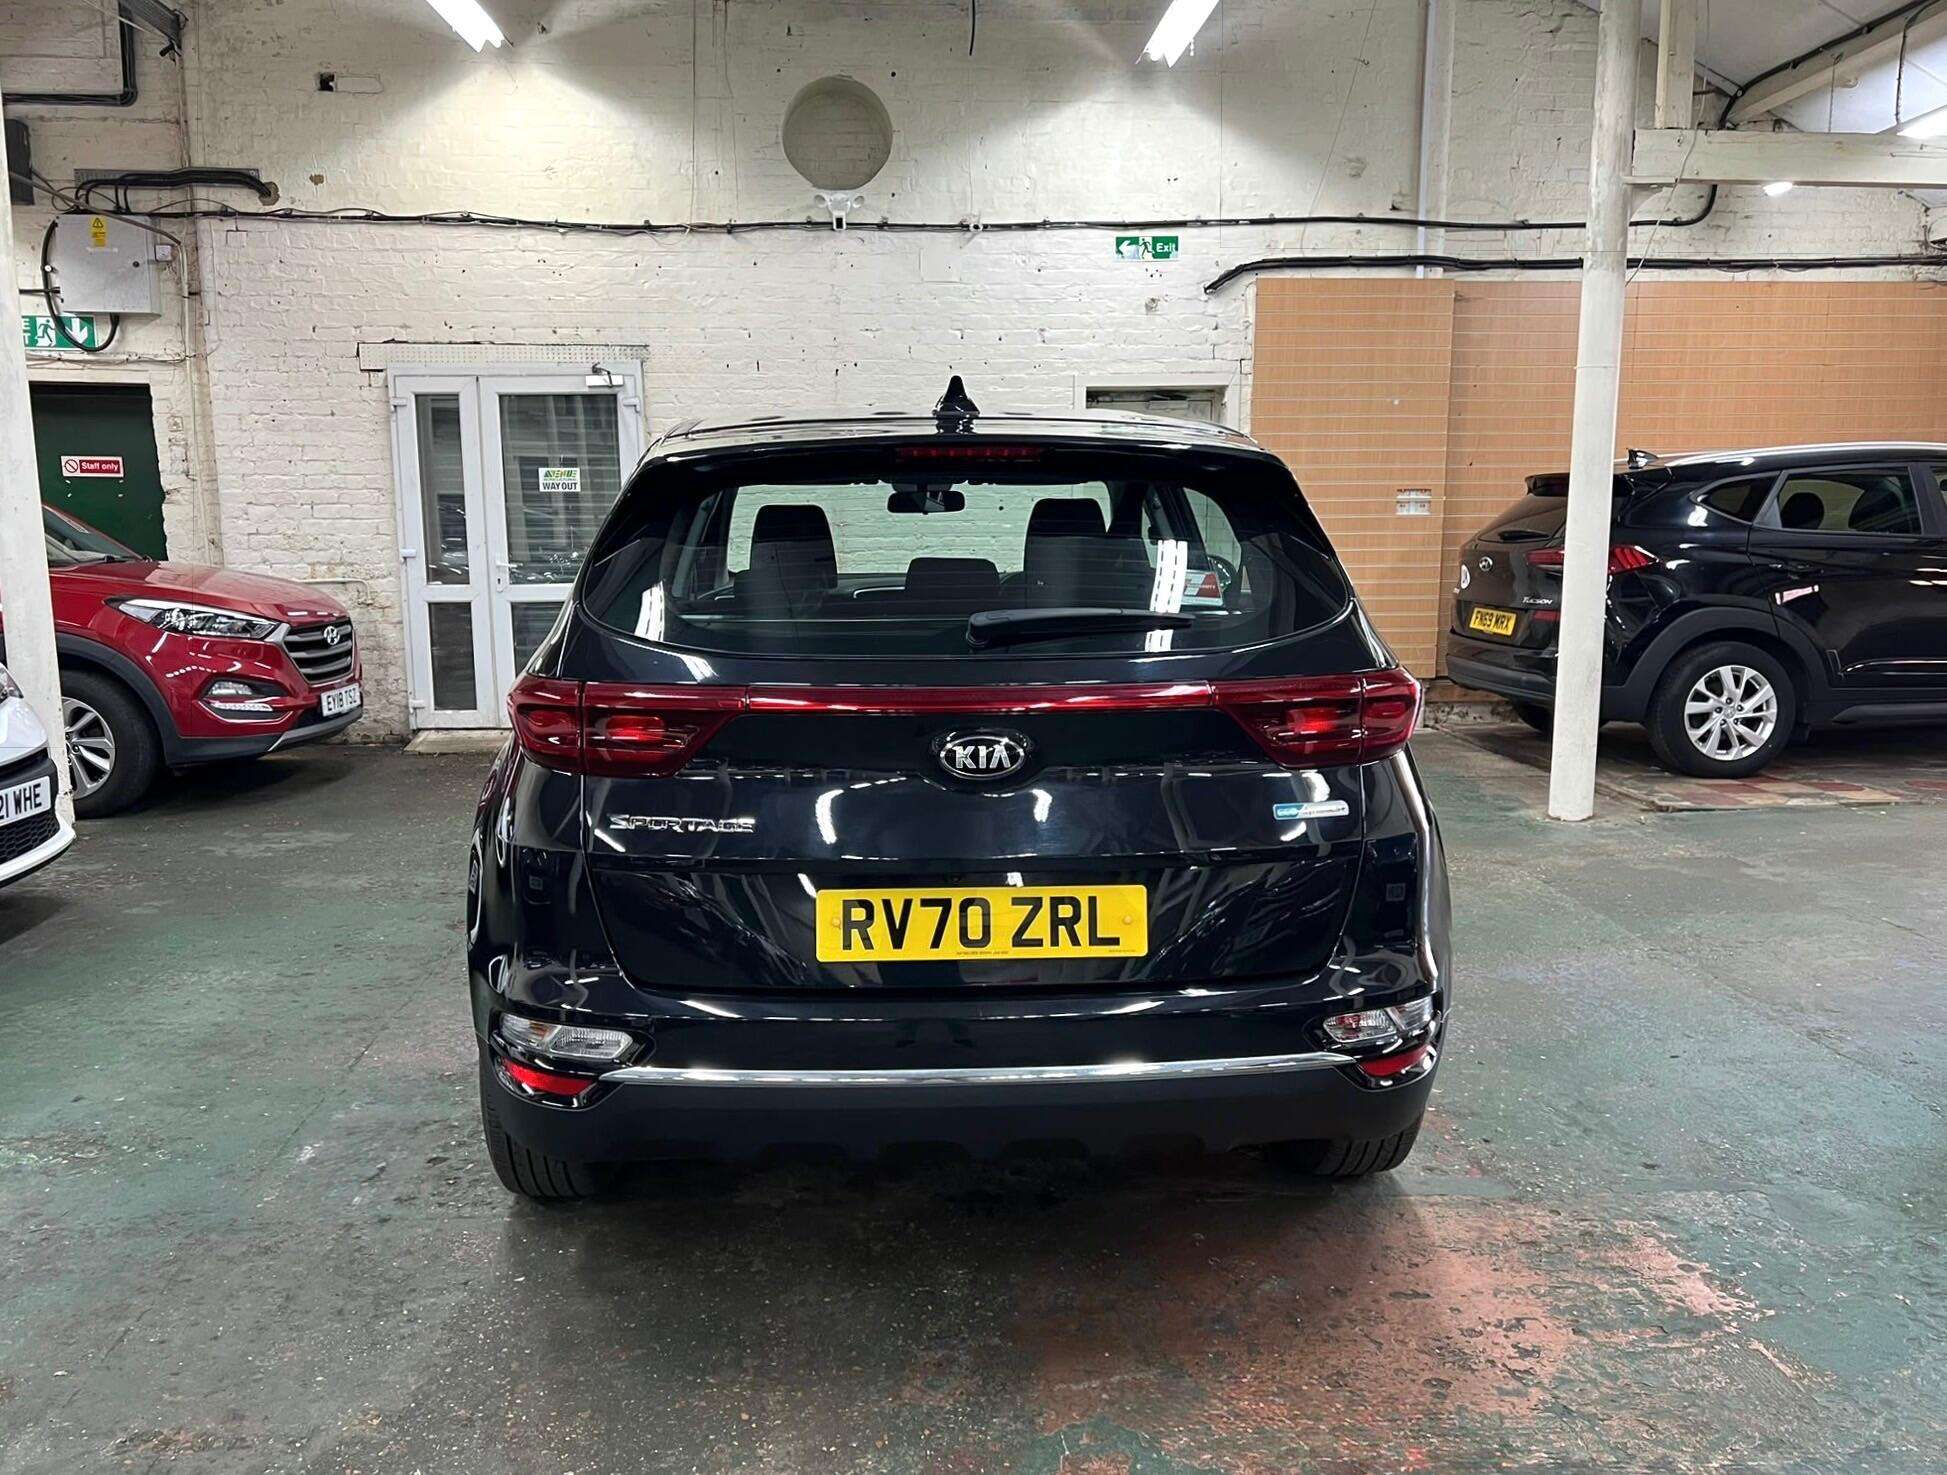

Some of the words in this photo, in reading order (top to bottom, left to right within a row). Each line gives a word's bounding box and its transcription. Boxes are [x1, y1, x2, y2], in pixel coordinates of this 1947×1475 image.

[1156, 242, 1176, 253] Exit
[81, 461, 101, 470] Staff
[101, 462, 119, 472] only
[542, 482, 560, 490] WAY
[561, 482, 577, 490] OUT
[952, 744, 1011, 769] KIA
[13, 782, 42, 815] WHE
[608, 814, 756, 833] SPORTAGE
[841, 896, 992, 951] RV70
[1010, 895, 1121, 948] ZRL
